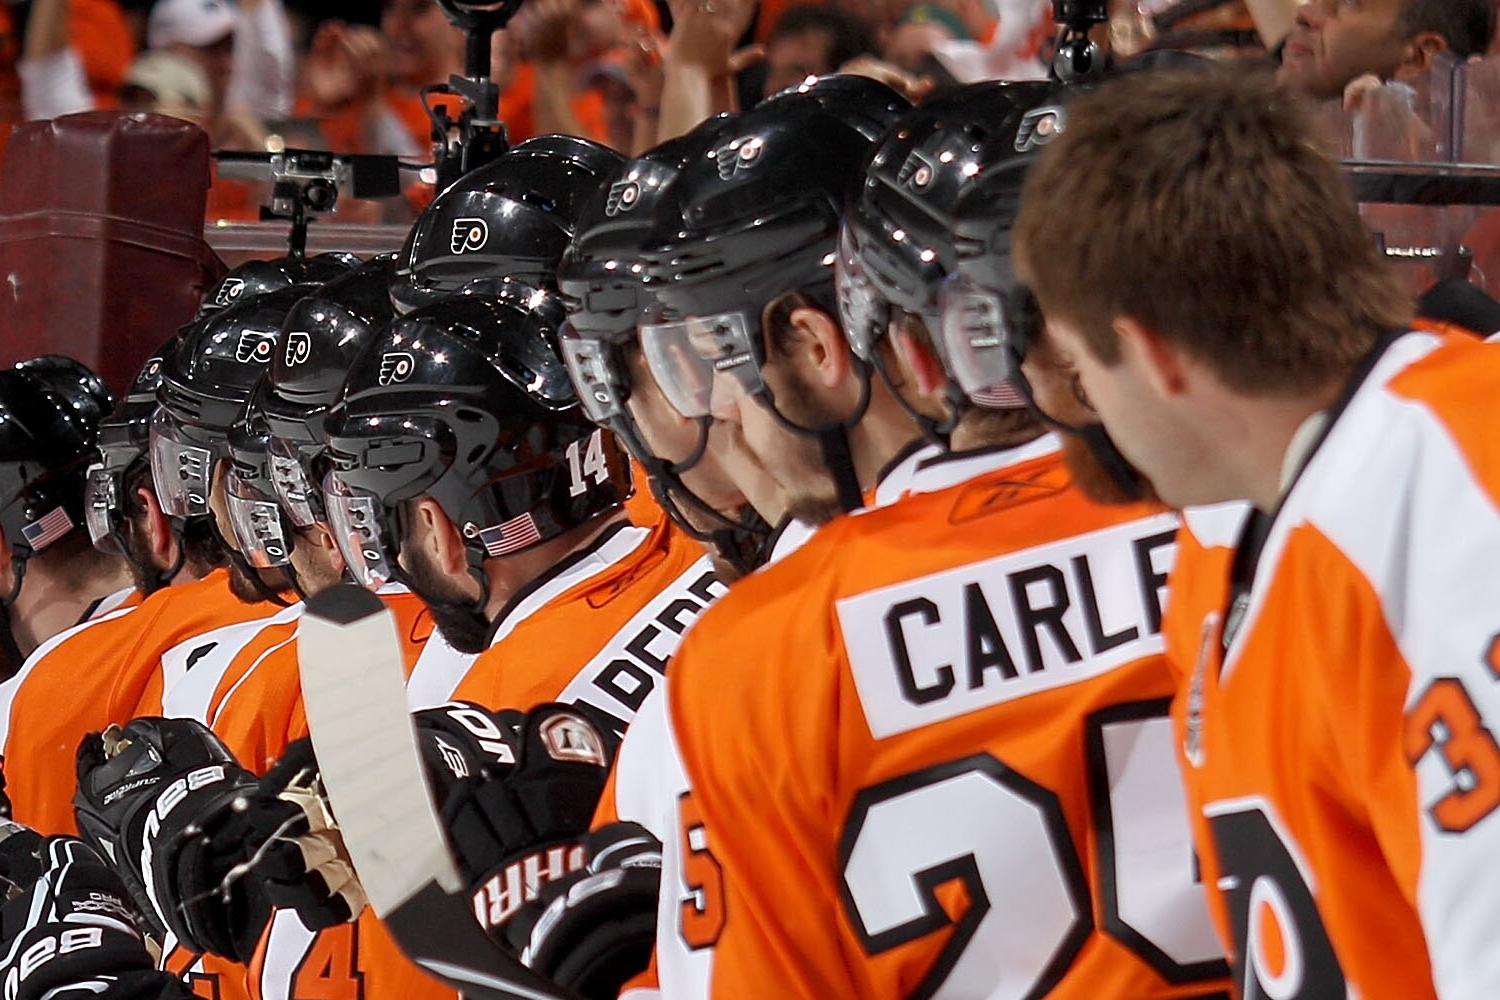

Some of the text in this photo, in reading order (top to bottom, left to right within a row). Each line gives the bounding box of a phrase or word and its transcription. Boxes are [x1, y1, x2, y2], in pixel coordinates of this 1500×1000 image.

[565, 428, 609, 497] 14
[1398, 640, 1500, 834] 3
[677, 791, 727, 951] 5
